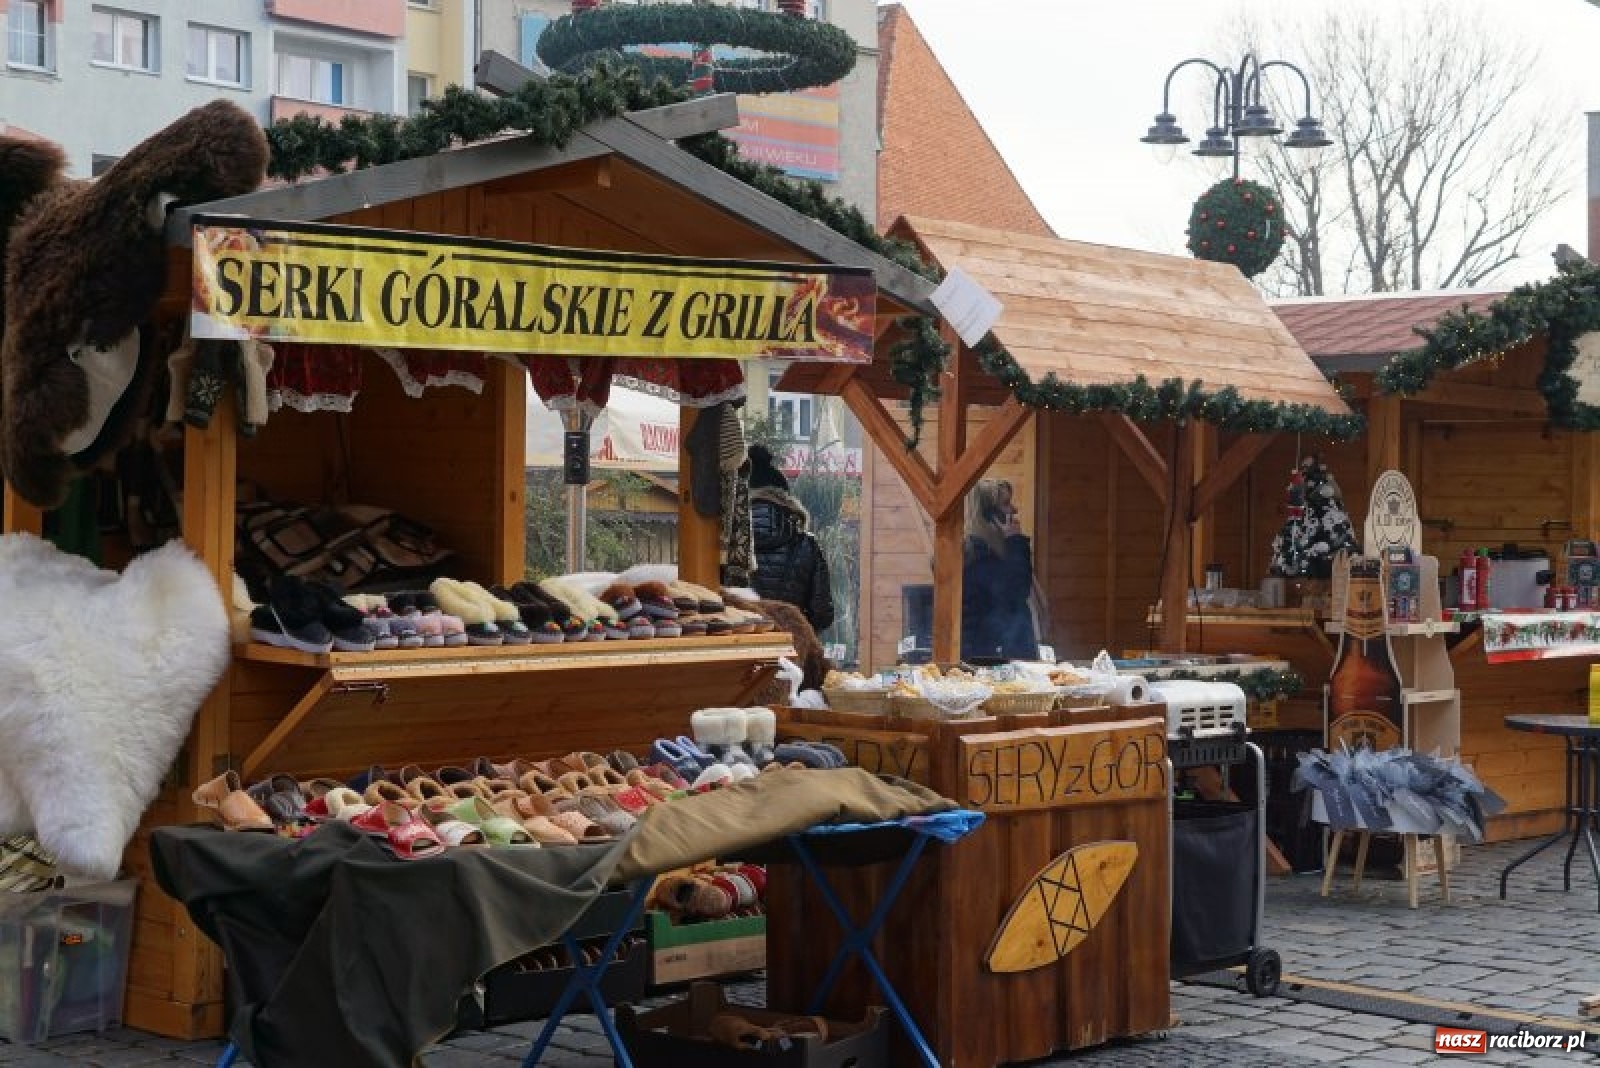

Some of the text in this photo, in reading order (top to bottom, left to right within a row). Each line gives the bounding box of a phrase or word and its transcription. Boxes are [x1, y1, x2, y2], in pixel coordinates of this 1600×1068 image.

[215, 253, 816, 343] SERKI GÓRALSKIE Z GRILLA
[968, 738, 1067, 807] SERY
